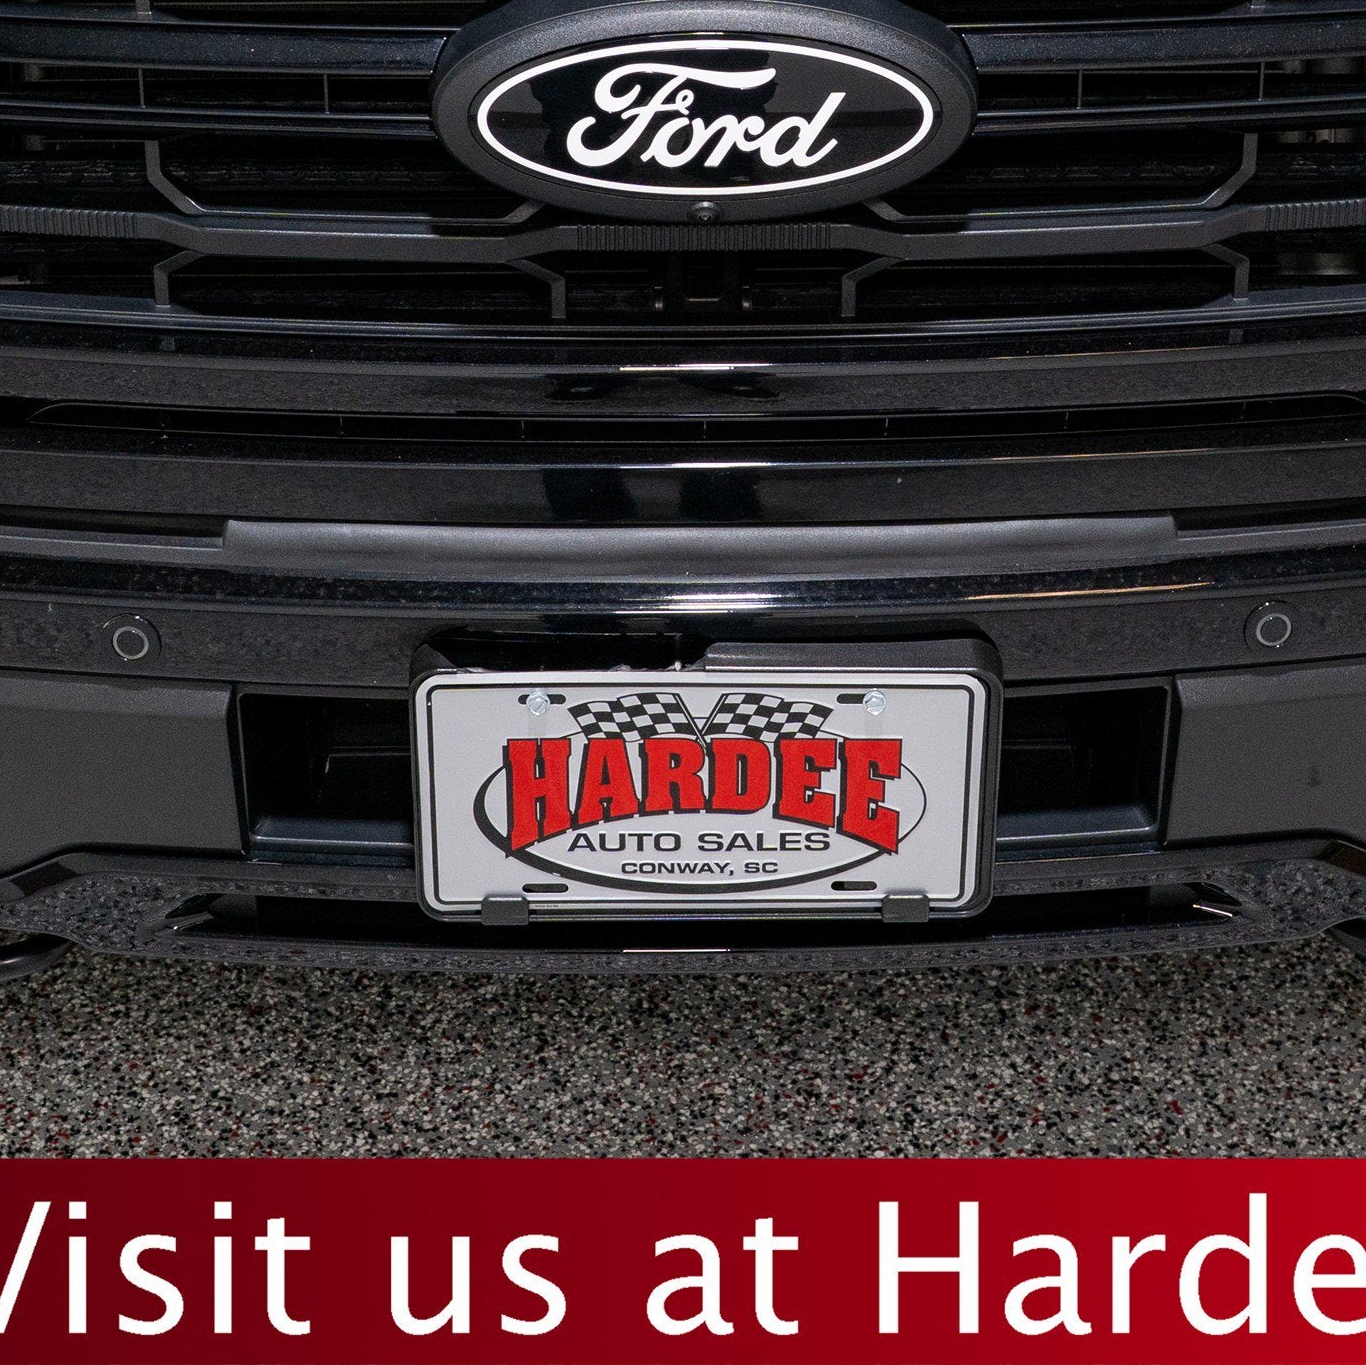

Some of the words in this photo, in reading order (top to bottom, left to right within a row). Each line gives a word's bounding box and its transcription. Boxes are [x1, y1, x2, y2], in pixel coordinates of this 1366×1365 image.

[566, 62, 846, 168] Ford
[502, 737, 903, 856] HARDEE
[567, 832, 682, 852] AUTO
[697, 832, 831, 852] SALES
[621, 861, 734, 877] CONWAY,
[744, 861, 778, 874] SC
